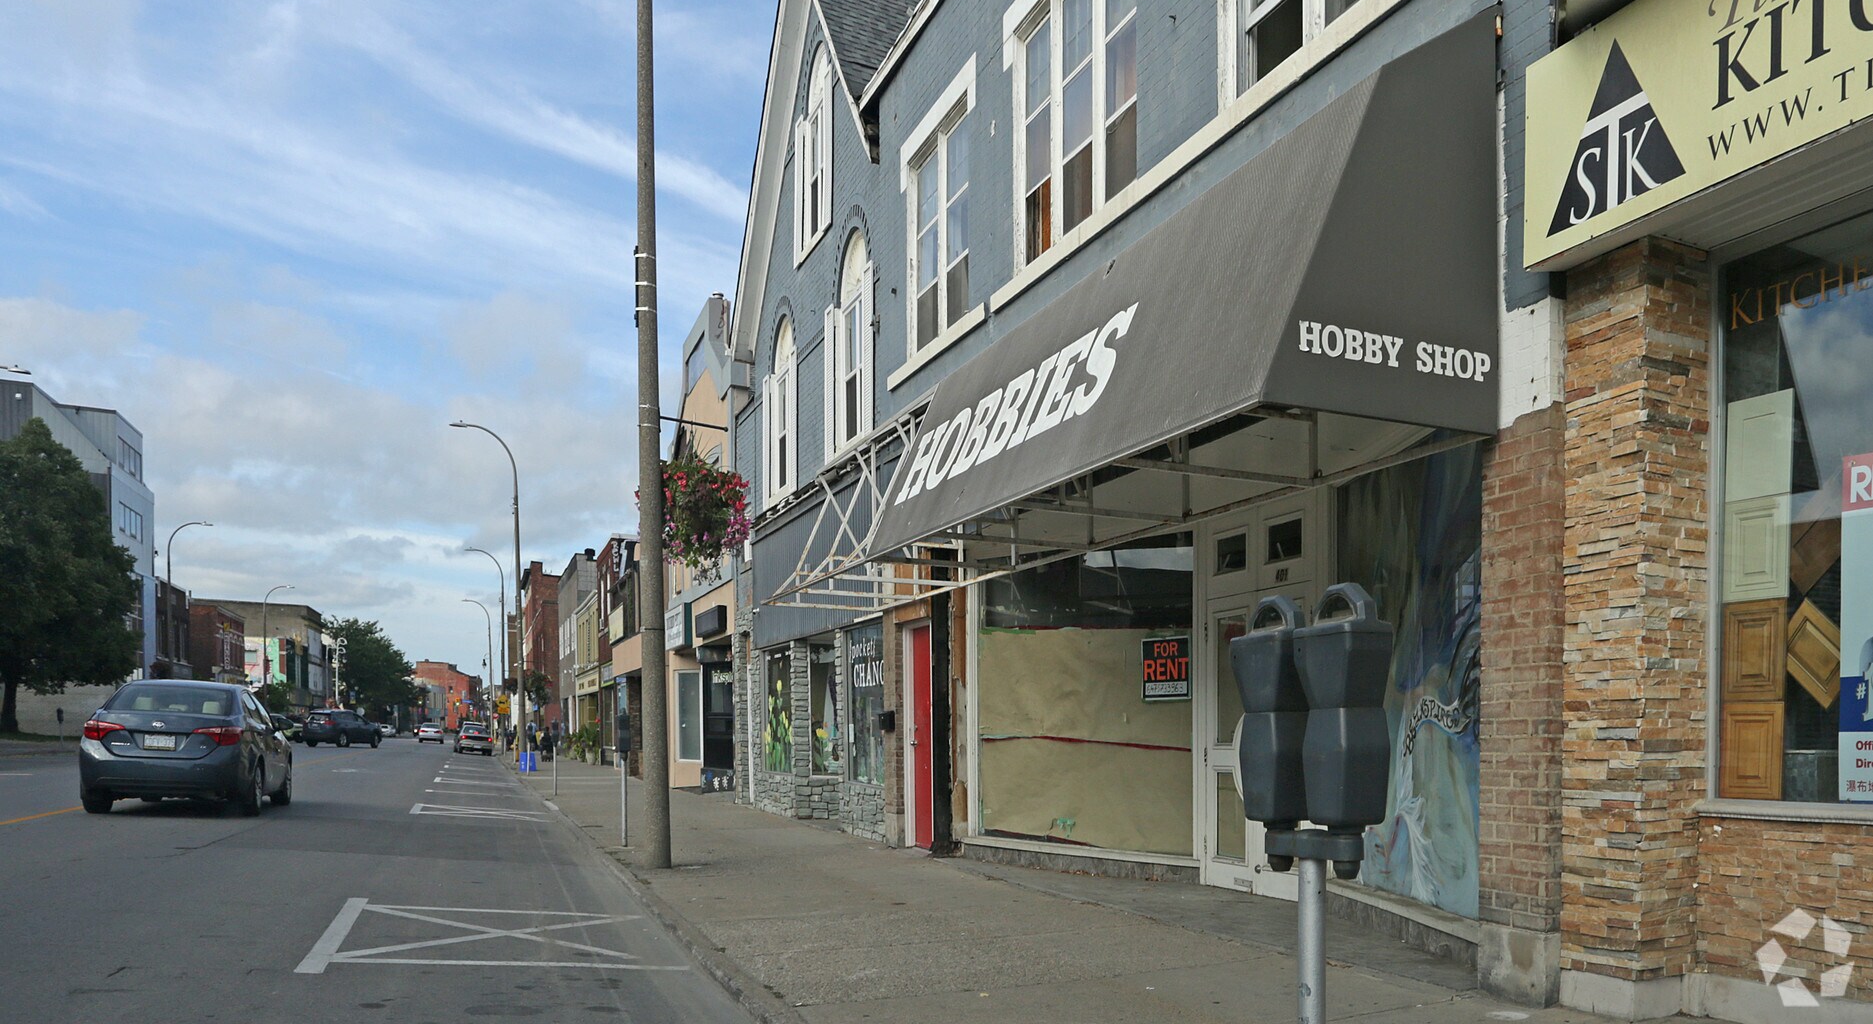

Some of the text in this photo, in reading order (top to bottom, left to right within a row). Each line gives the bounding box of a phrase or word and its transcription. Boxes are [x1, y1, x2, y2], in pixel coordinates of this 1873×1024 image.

[1299, 320, 1491, 382] HOBBY SHOP
[894, 302, 1139, 506] HOBBIES
[1850, 463, 1873, 504] R
[1143, 657, 1189, 681] RENT
[1153, 641, 1179, 657] FOR
